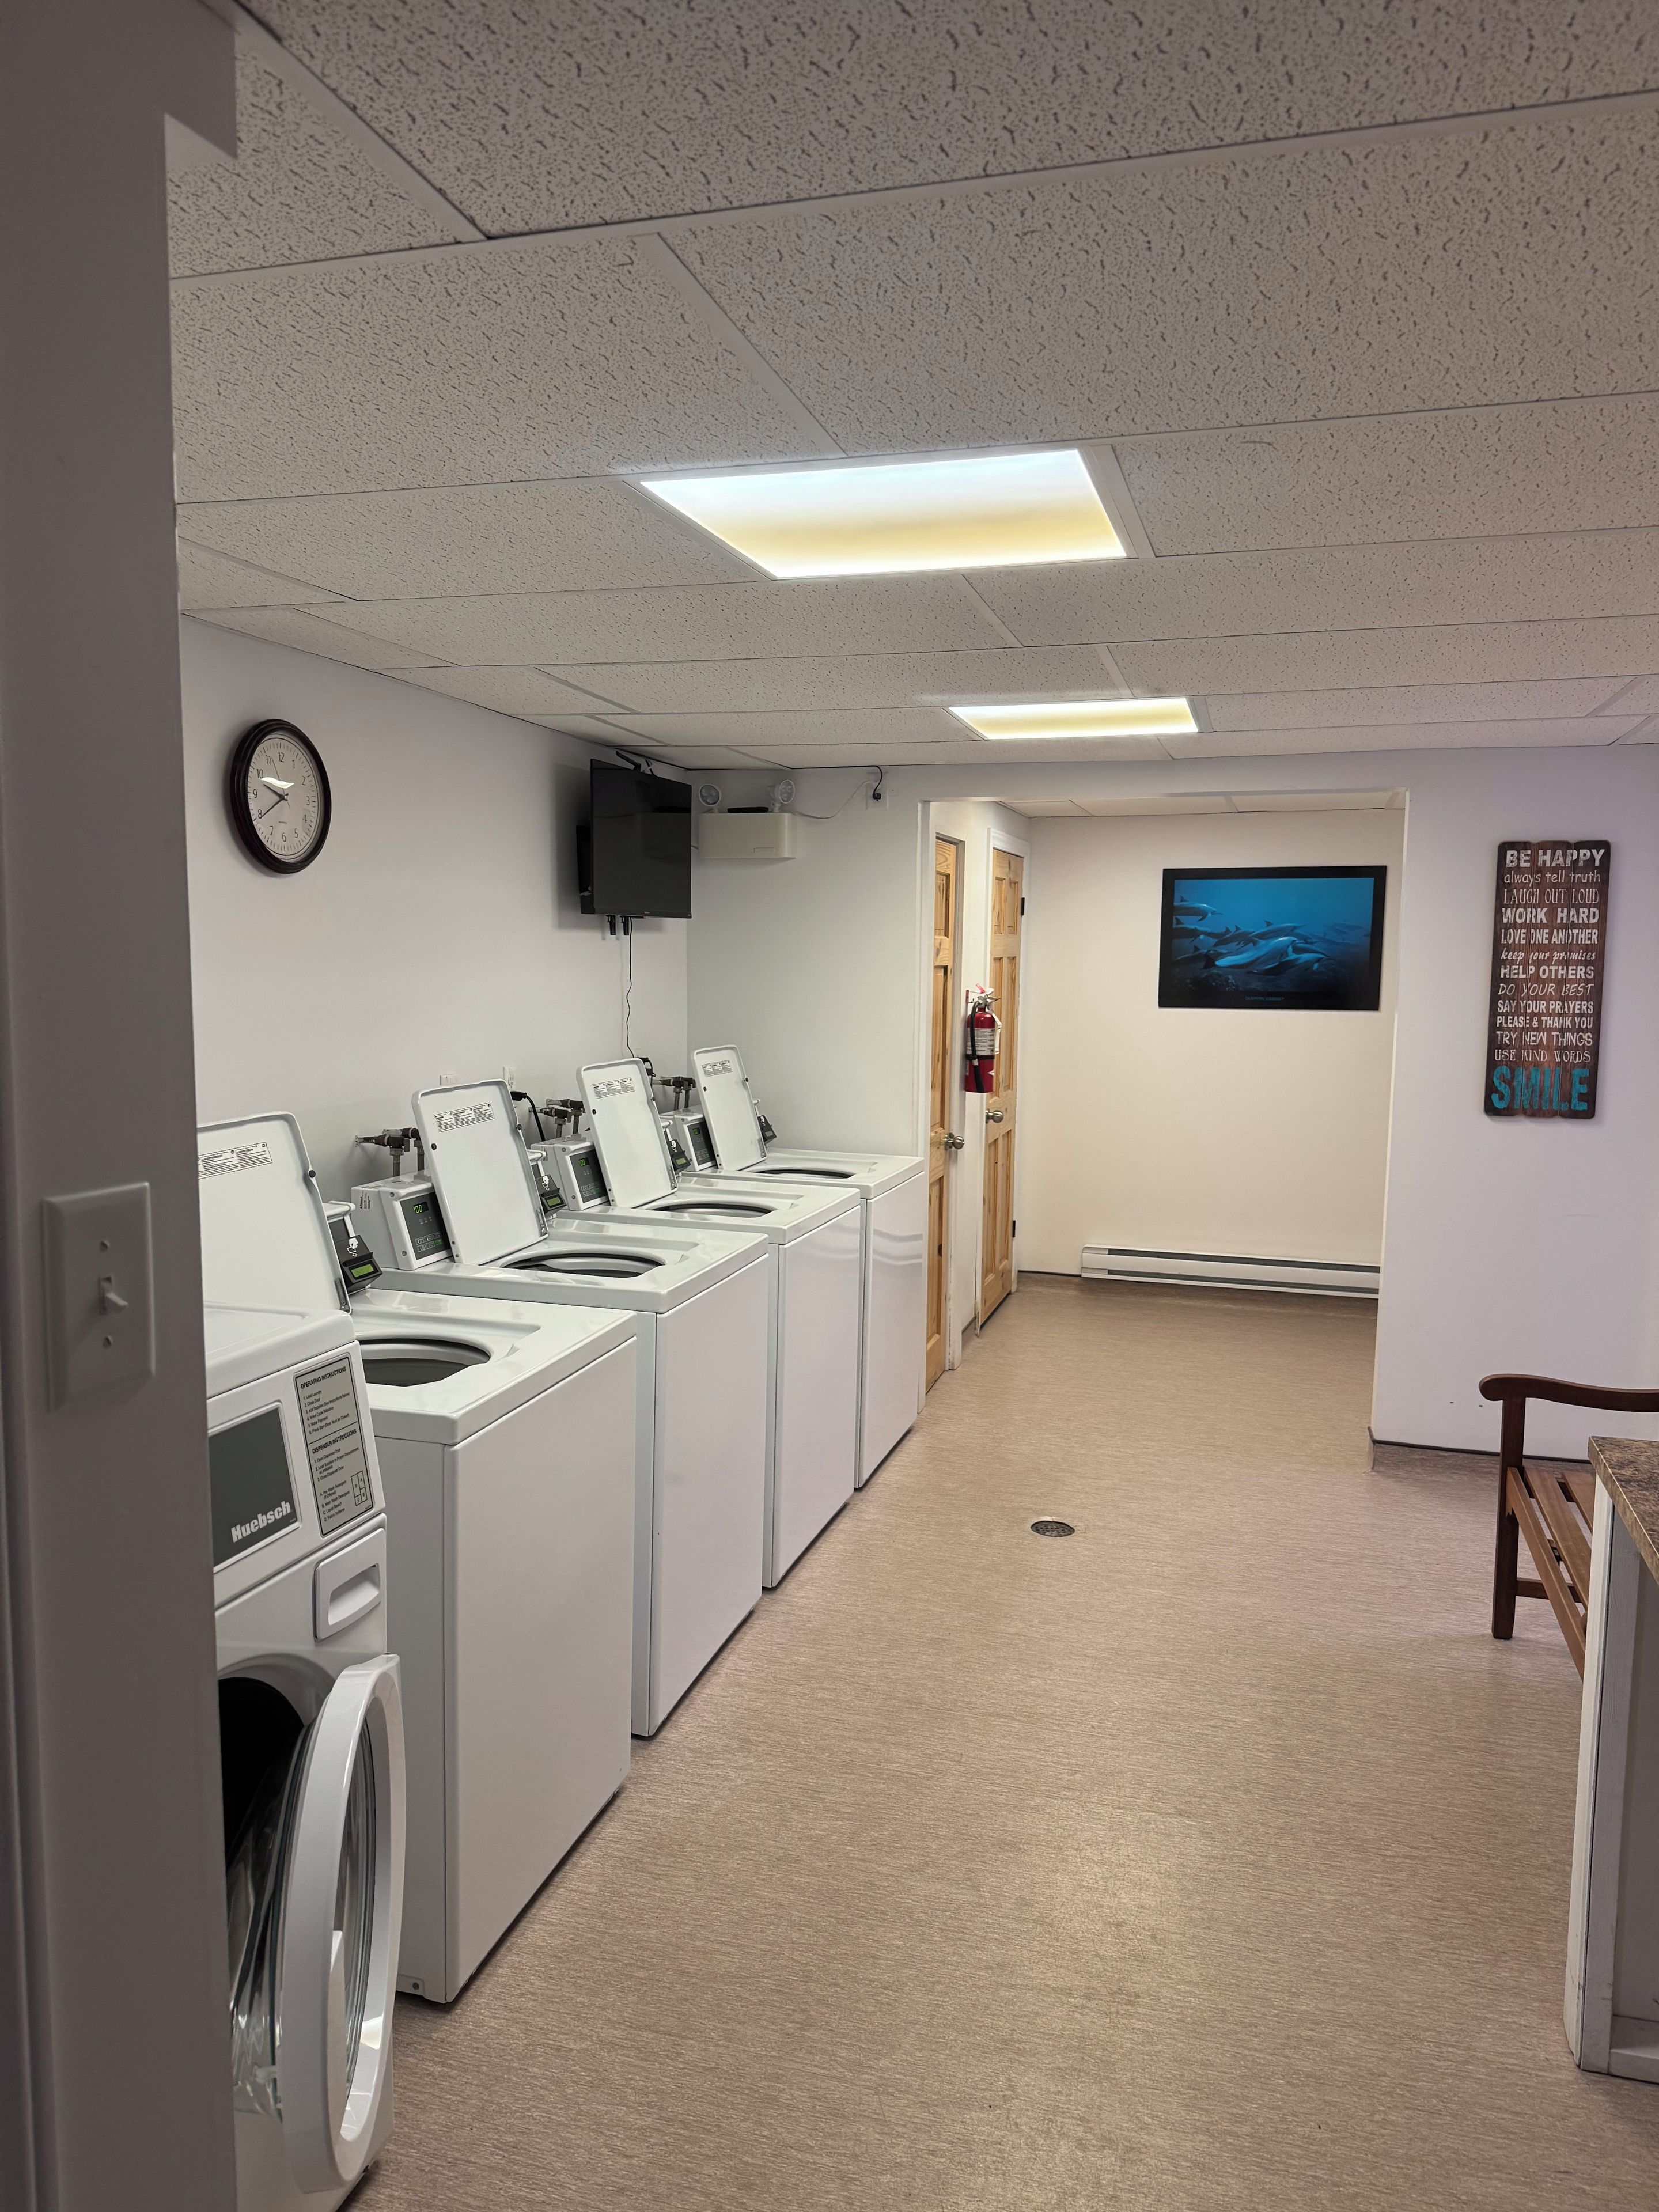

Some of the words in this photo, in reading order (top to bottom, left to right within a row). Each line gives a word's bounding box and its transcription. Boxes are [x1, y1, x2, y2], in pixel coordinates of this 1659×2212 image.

[266, 755, 271, 765] 11
[278, 752, 284, 763] 12
[292, 760, 296, 769] 1
[256, 769, 263, 778] 10
[301, 775, 306, 786] 2
[253, 789, 257, 798] 9
[306, 796, 310, 806] 3
[258, 809, 262, 819] 8
[302, 814, 308, 823] 4
[270, 826, 274, 836] 7
[282, 833, 286, 842] 6
[294, 828, 298, 838] 5
[1506, 850, 1531, 868] BE
[1537, 849, 1605, 867] HAPPY
[1504, 870, 1541, 887] always
[1546, 870, 1565, 882] tell
[1569, 870, 1600, 882] truth
[1503, 889, 1539, 904] LAUGH
[1544, 889, 1567, 904] OUT
[1572, 889, 1599, 904] LOUD
[1502, 908, 1547, 923] WORK
[1557, 908, 1599, 923] HARD
[1501, 929, 1527, 944] LOVE
[1530, 929, 1549, 944] ONE
[1551, 929, 1598, 944] ANOTHER
[1501, 948, 1524, 964] keep
[1529, 951, 1550, 964] your
[1552, 950, 1596, 964] promises
[1501, 965, 1535, 978] HELP
[1539, 965, 1594, 979] OTHERS
[1498, 983, 1515, 995] DO
[1521, 983, 1555, 997] YOUR
[1562, 983, 1594, 996] BEST
[1498, 1000, 1517, 1013] SAY
[1519, 1000, 1546, 1013] YOUR
[1550, 1001, 1594, 1014] PRAYERS
[1497, 1016, 1529, 1028] PLEASE
[1532, 1016, 1538, 1028] &
[1541, 1017, 1571, 1028] THANK
[1575, 1017, 1593, 1029] YOU
[1496, 1031, 1518, 1045] TRY
[1522, 1032, 1547, 1045] NEW
[1551, 1032, 1593, 1046] THINGS
[1494, 1050, 1516, 1061] USE
[1521, 1050, 1547, 1062] KIND
[1554, 1050, 1590, 1063] WORDS
[1491, 1066, 1589, 1111] SMILE
[301, 1377, 321, 1389] OPERATING
[321, 1366, 346, 1380] INSTRUCTIONS
[312, 1441, 332, 1453] DISPENSER
[332, 1429, 357, 1444] INSTRUCTIONS
[231, 1501, 291, 1543] Huebsch
